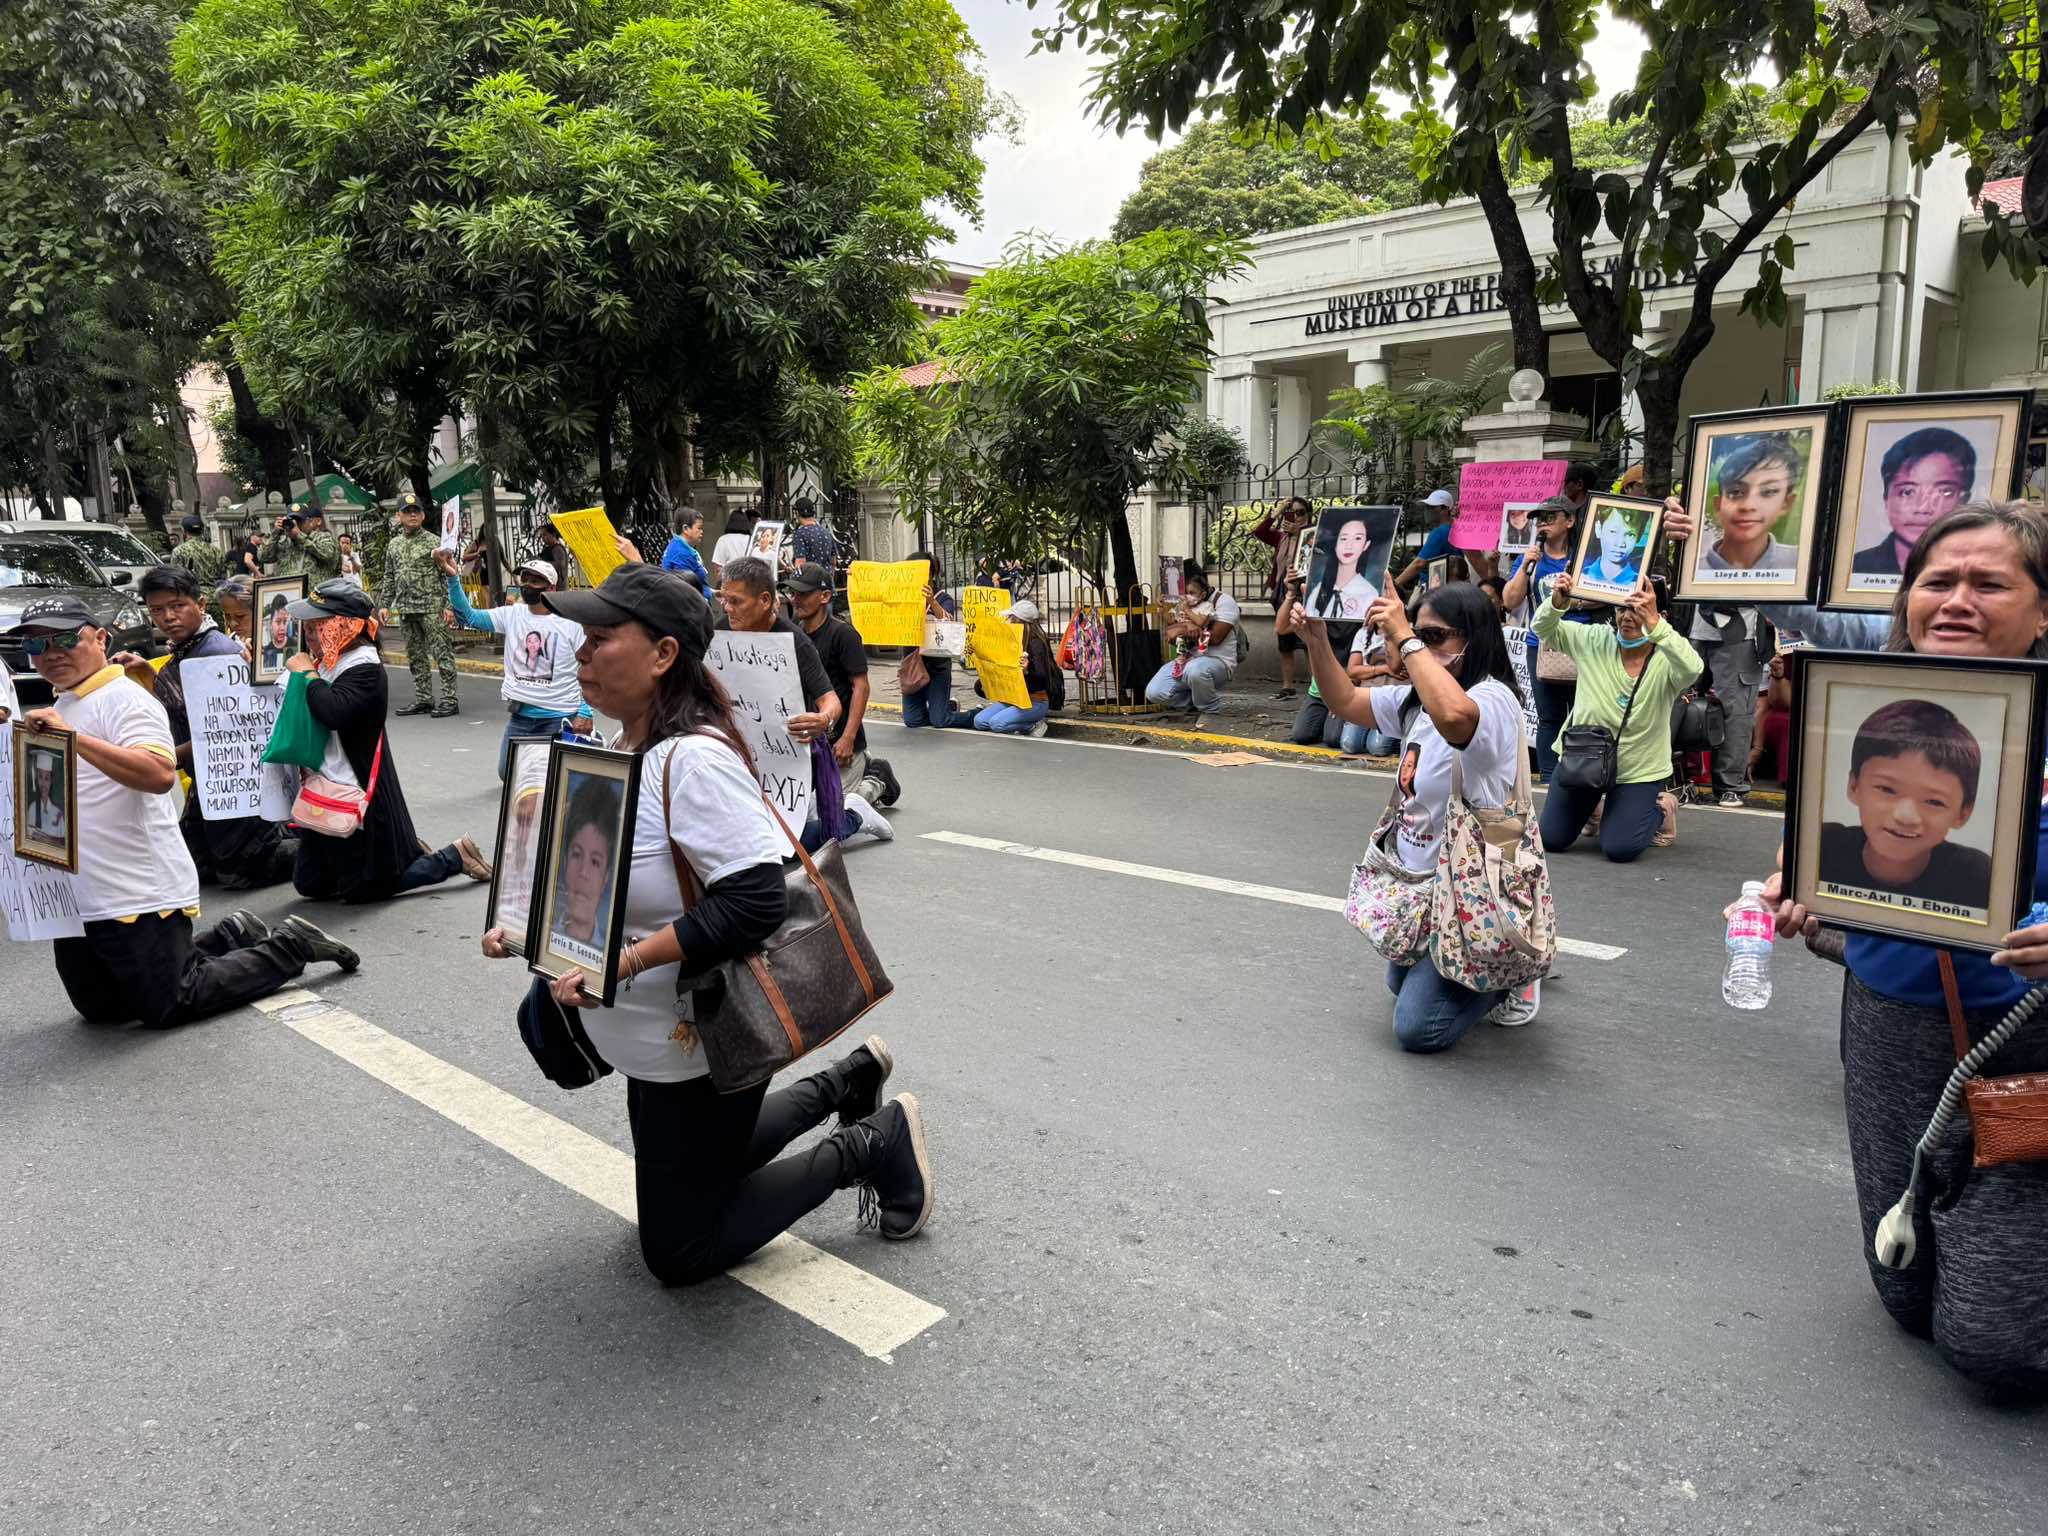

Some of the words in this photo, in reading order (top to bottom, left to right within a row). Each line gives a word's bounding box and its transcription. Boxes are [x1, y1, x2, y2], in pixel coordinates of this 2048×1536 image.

[1327, 286, 1417, 312] UNIVERSITY
[1424, 283, 1445, 298] OF
[1453, 278, 1481, 294] THE
[1305, 303, 1397, 336] MUSEUM
[1405, 299, 1437, 320] OF
[1444, 296, 1460, 315] A
[206, 696, 240, 713] HINDI
[249, 695, 267, 711] PO
[204, 714, 220, 729] NA
[208, 746, 245, 763] NAMIN
[207, 762, 245, 780] MAISIP
[207, 797, 238, 812] MUNA
[28, 878, 80, 923] NAMIN
[1902, 897, 1917, 908] D.
[1922, 900, 1971, 918] Eboña
